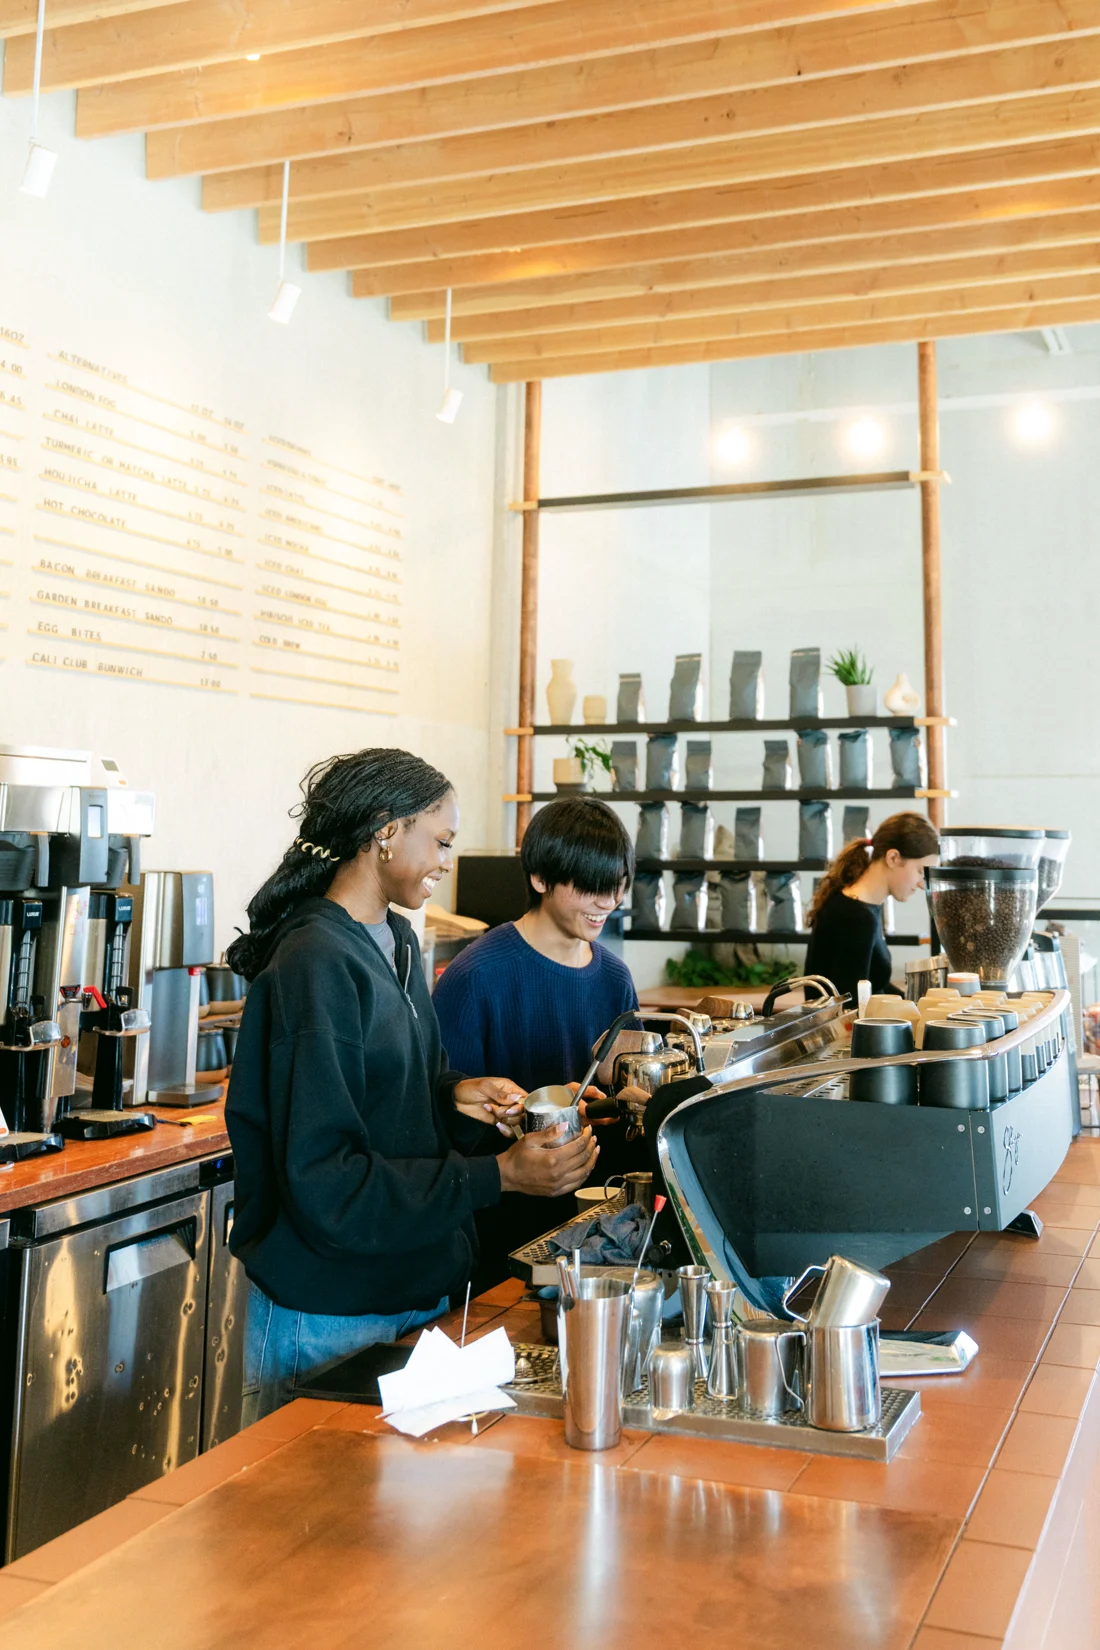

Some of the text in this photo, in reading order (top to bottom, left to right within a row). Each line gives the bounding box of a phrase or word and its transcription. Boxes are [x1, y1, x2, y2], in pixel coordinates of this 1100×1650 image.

[58, 350, 128, 384] ALTERNATIVES
[56, 379, 117, 409] LONDON FOG
[54, 409, 114, 437] CHAI LATTE
[45, 436, 94, 459] TURMERIC
[101, 454, 114, 467] OR
[119, 460, 155, 481] MATCHA
[162, 474, 188, 490] LATTE
[109, 486, 137, 503] LATTE
[43, 497, 127, 529] HOT CHOCOLATE
[39, 558, 75, 576] BACON
[86, 568, 137, 588] BREAKFAST
[145, 582, 176, 598] SANDO
[36, 589, 78, 606] GARDEN
[84, 599, 137, 618] BREAKFAST
[145, 610, 173, 625] SANDO
[37, 621, 59, 634] EGG
[71, 627, 102, 642] BITES
[32, 651, 58, 665] CALI
[63, 656, 88, 669] CLUB
[97, 661, 144, 678] BUNWICH
